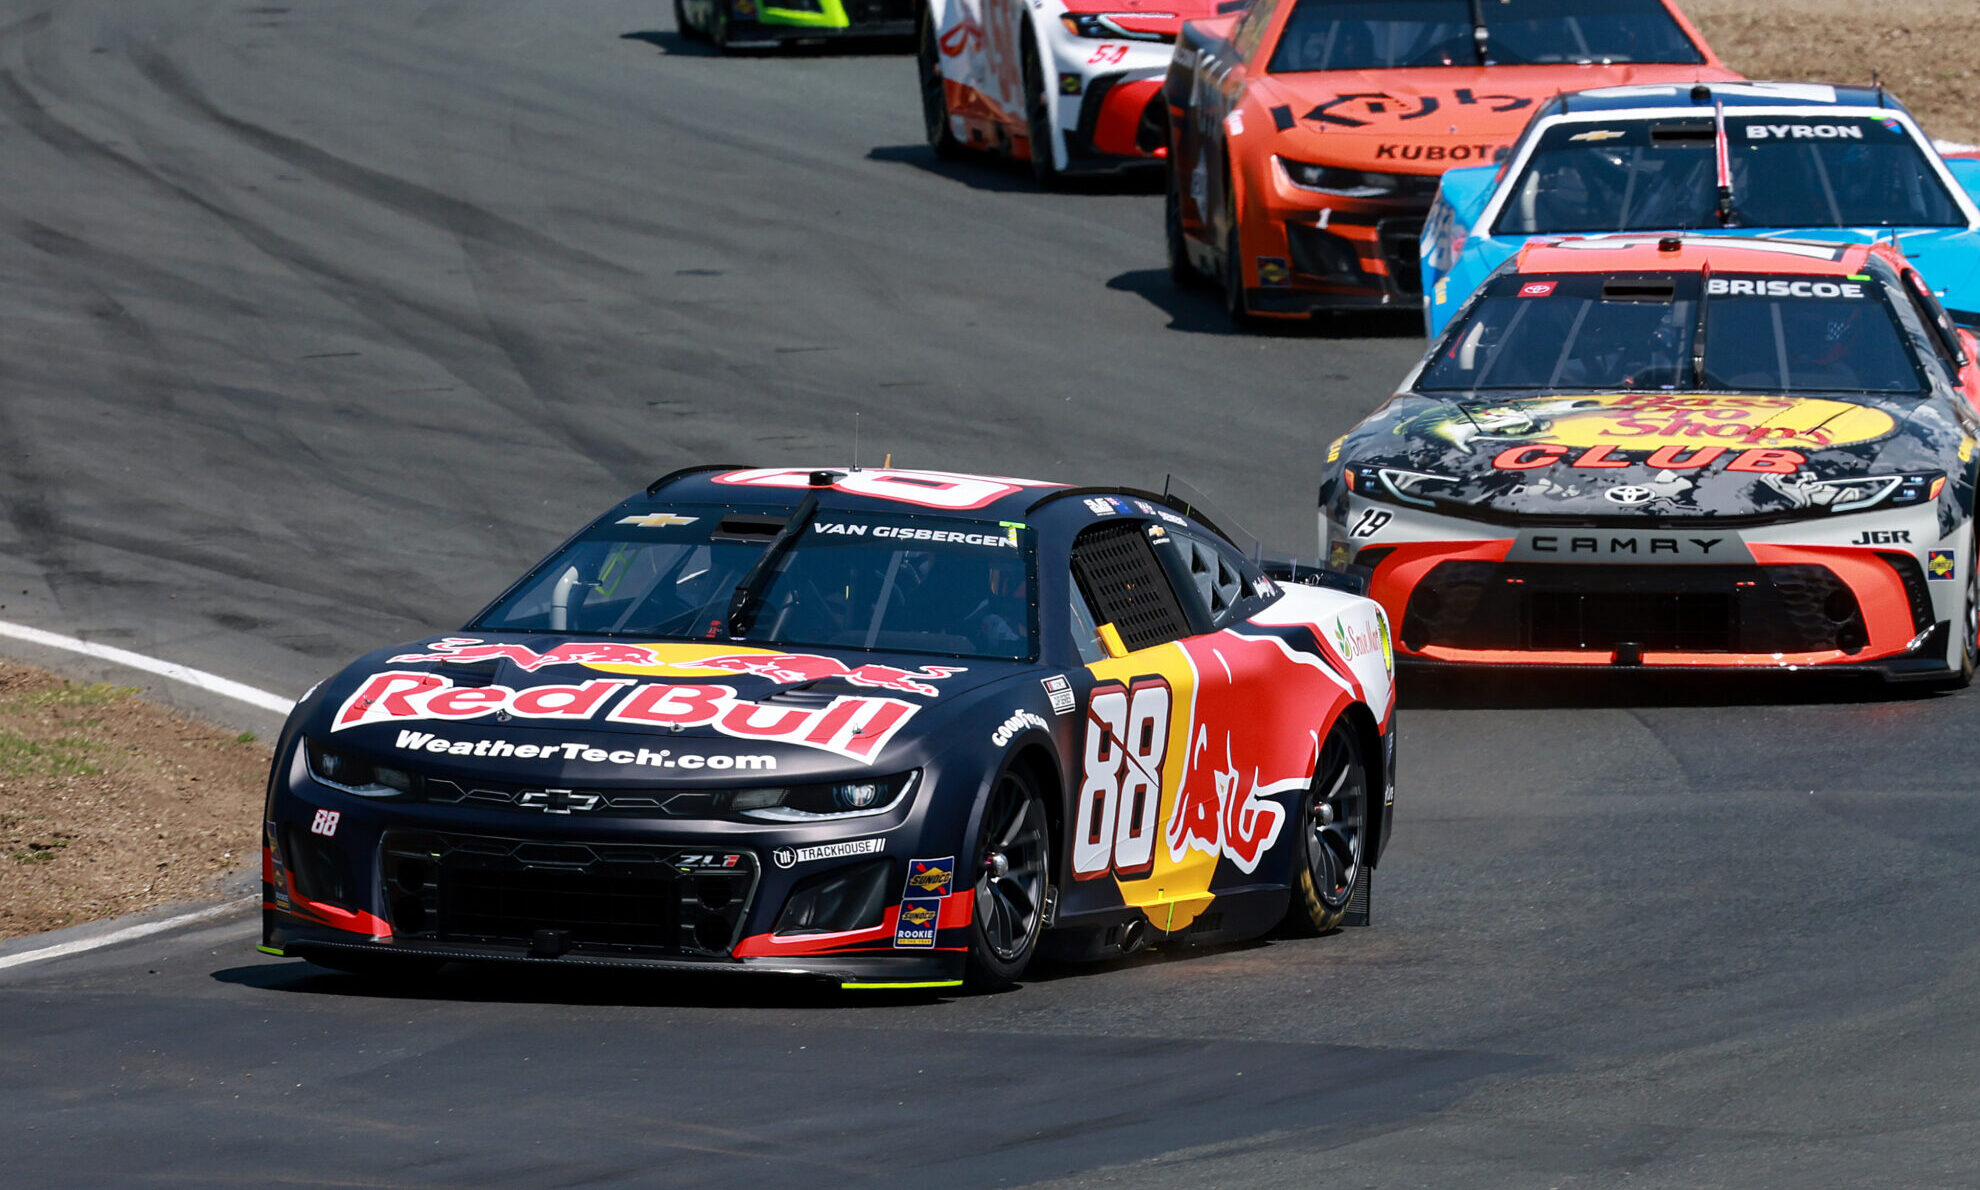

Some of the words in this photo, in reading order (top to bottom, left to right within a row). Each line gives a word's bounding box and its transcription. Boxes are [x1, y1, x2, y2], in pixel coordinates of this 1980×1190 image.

[1087, 44, 1129, 65] 54
[1746, 125, 1863, 139] BYRON
[1375, 144, 1512, 161] KUBOT
[1708, 279, 1865, 298] BRISCOE
[1598, 417, 1834, 446] Shops
[1493, 444, 1807, 475] CLUB
[813, 522, 866, 536] VAN
[1350, 508, 1394, 539] 19
[1532, 535, 1724, 554] CAMRY
[1852, 531, 1913, 545] JGR
[331, 671, 628, 732] Red
[605, 683, 922, 765] Bull
[1072, 674, 1173, 882] 88
[311, 809, 340, 837] 88
[802, 840, 872, 859] TRACKHOUSE
[898, 930, 933, 938] ROOKIE
